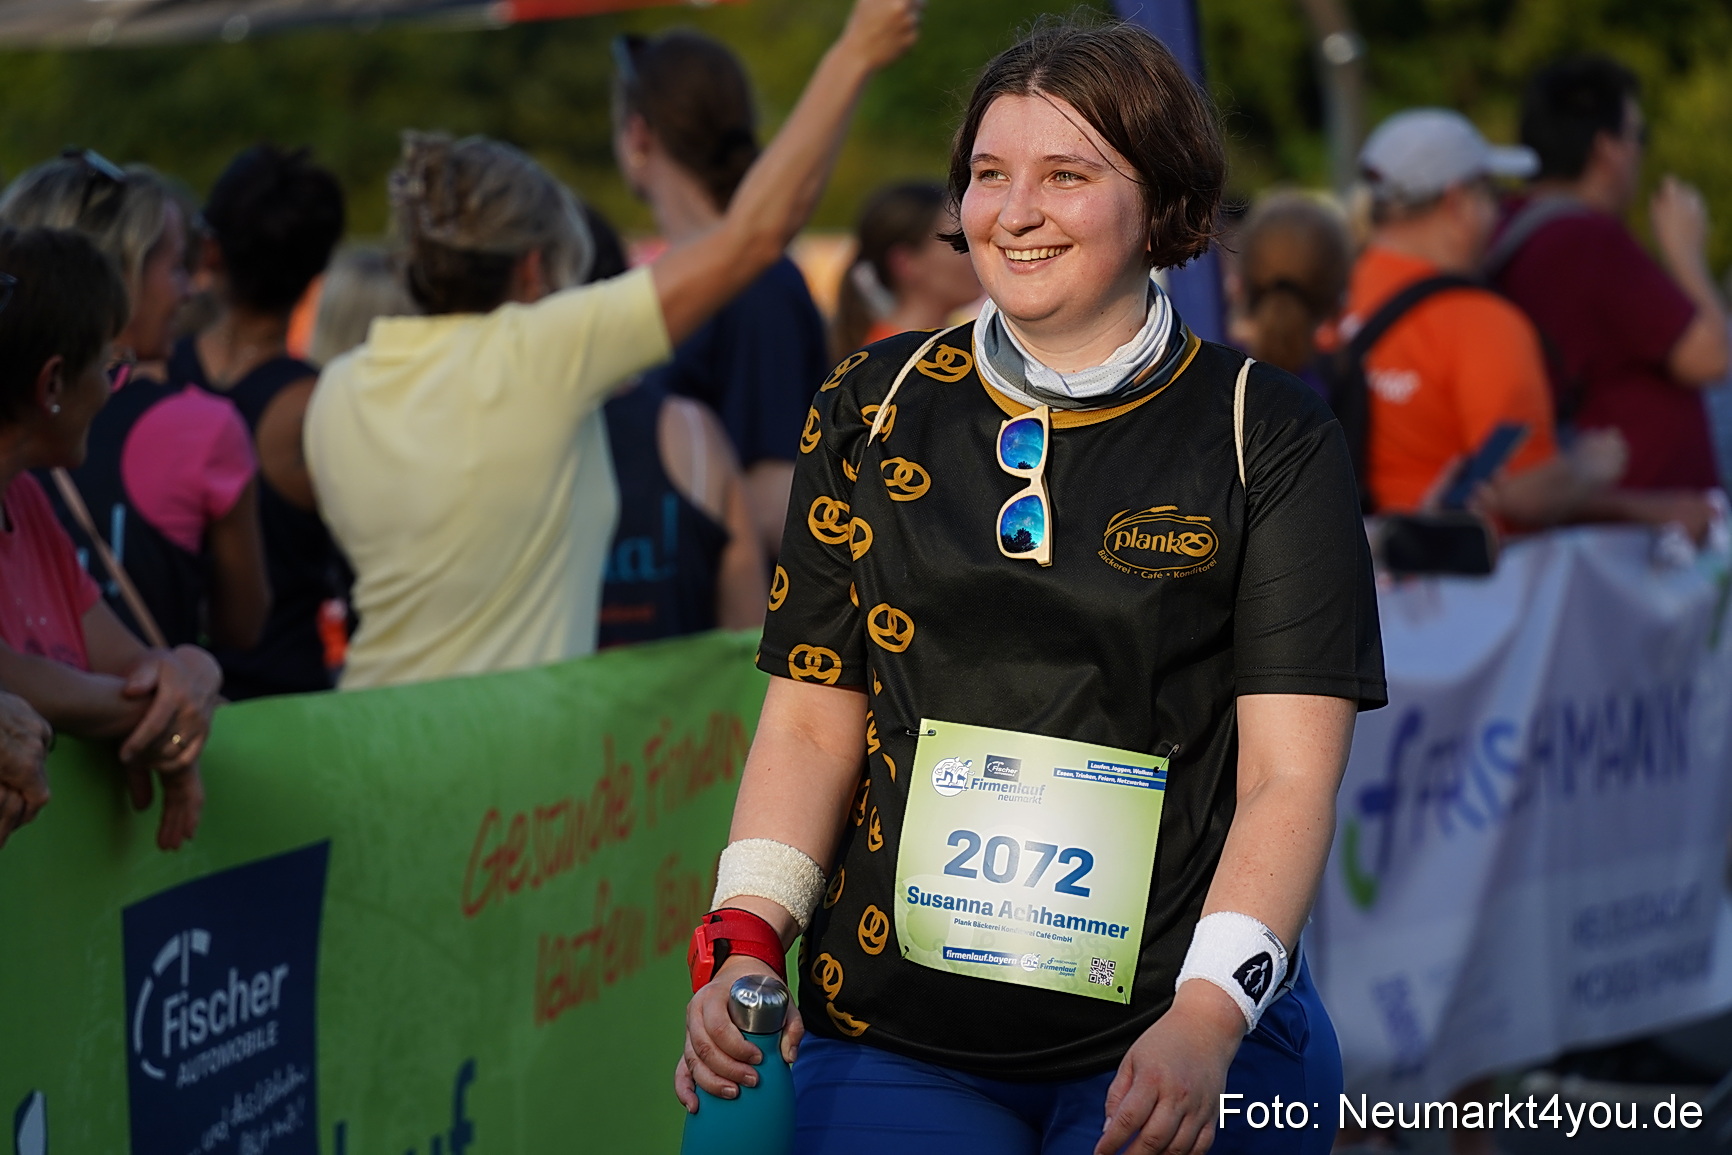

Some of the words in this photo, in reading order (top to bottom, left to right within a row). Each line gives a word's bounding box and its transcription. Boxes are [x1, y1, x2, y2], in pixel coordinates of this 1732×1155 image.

[1113, 526, 1184, 555] plank
[1097, 549, 1131, 575] Bäckerei
[1140, 571, 1163, 579] Café
[1173, 557, 1217, 579] Konditorei
[992, 765, 1018, 775] Fischer
[1110, 765, 1132, 775] Joggen,
[970, 777, 1046, 796] Firmenlauf
[1116, 777, 1150, 788] Netzwerken
[997, 793, 1042, 805] neumarkt
[943, 829, 1094, 898] 2072
[906, 885, 994, 917] Susanna
[998, 899, 1130, 940] Achhammer
[953, 917, 972, 927] Plank
[973, 919, 1001, 931] Bäckerei
[1035, 930, 1052, 940] Café
[1051, 933, 1073, 943] GmbH
[946, 949, 1017, 966] firmenlauf.bayern
[1039, 962, 1077, 974] Firmenlauf
[161, 961, 290, 1058] Fischer
